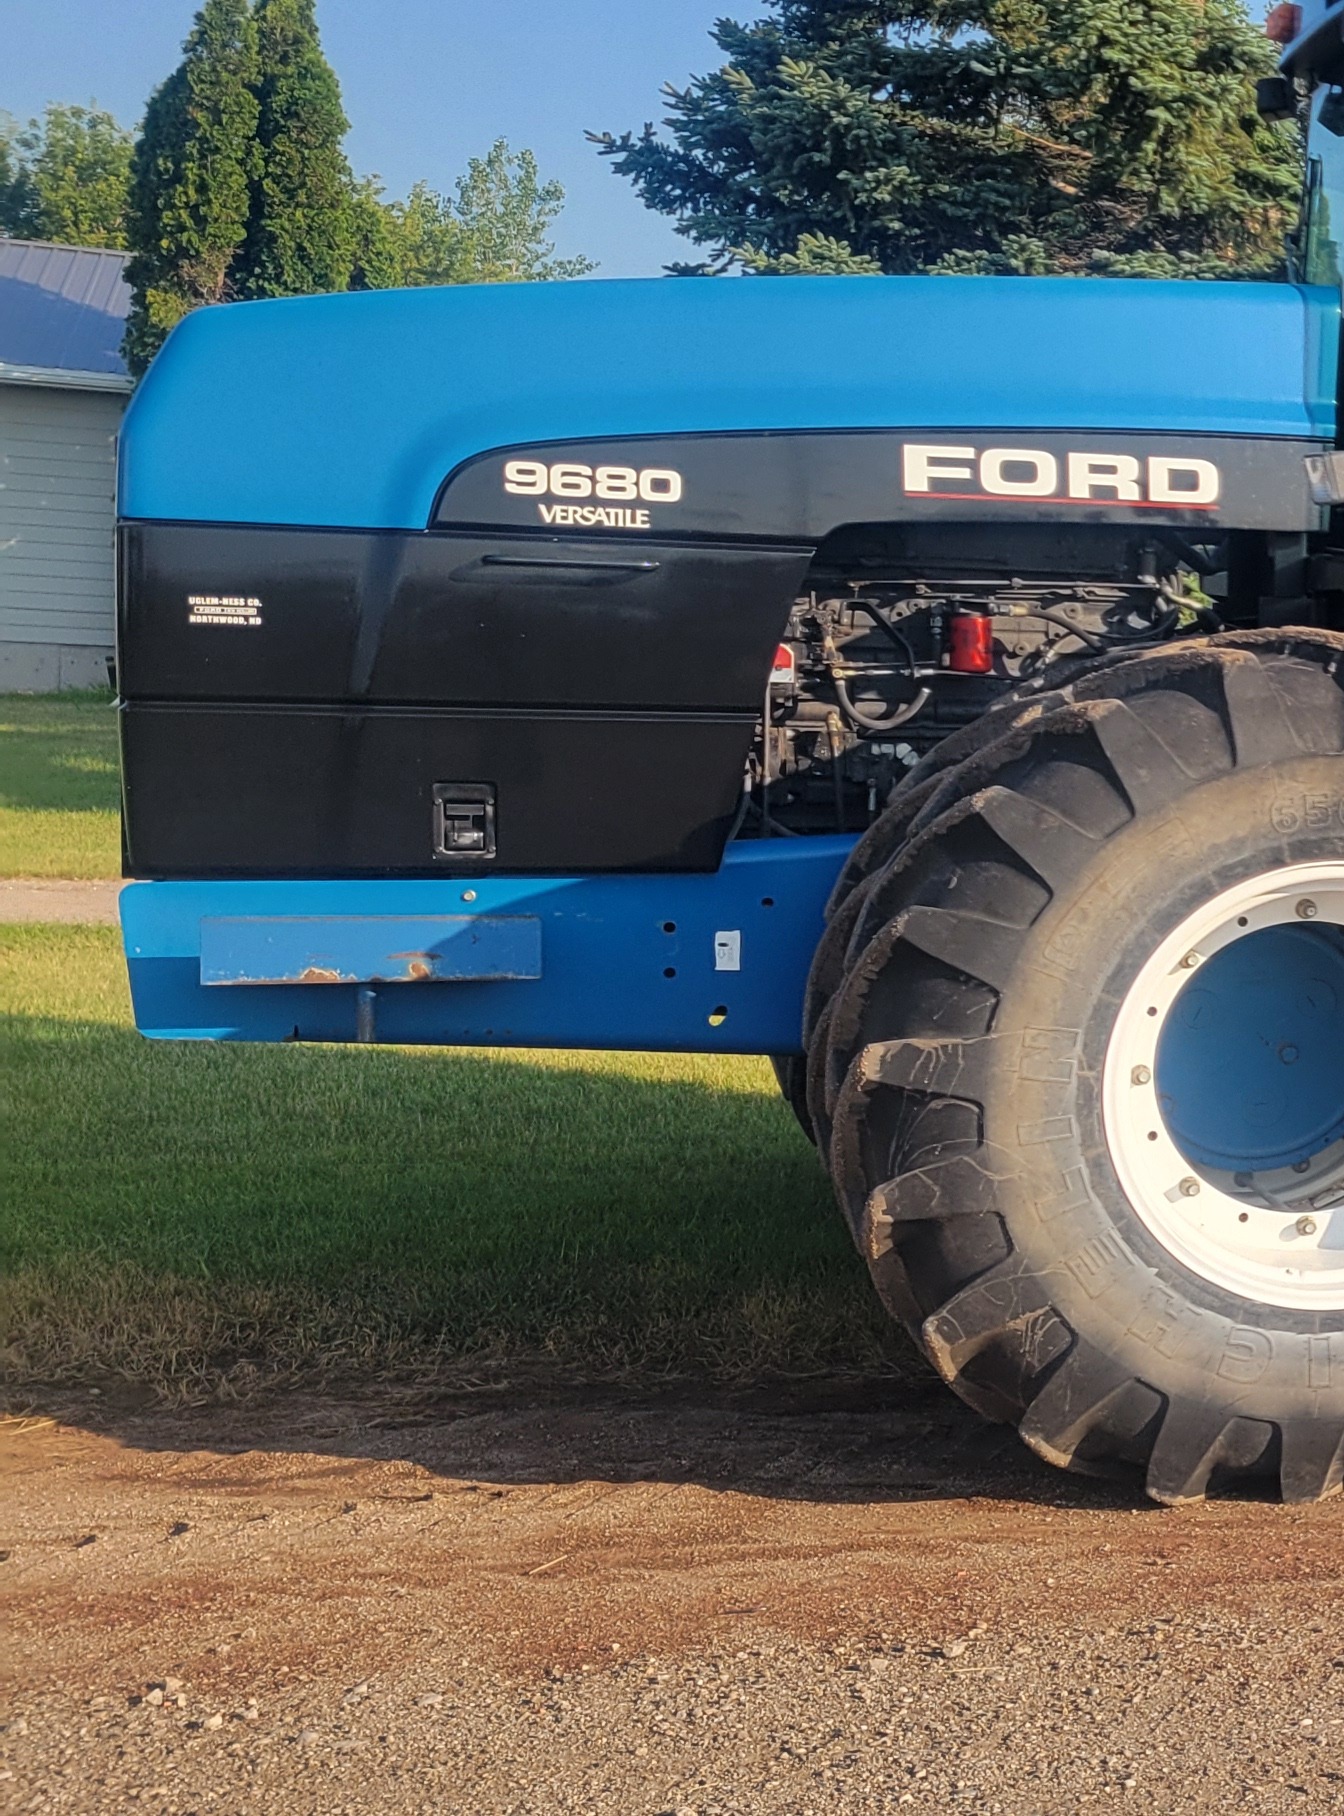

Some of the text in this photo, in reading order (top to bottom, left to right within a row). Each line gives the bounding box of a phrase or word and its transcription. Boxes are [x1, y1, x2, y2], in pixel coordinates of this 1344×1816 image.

[504, 461, 682, 503] 9680
[903, 444, 1219, 504] FORD
[538, 503, 651, 529] VERSATILE
[247, 597, 263, 607] CO.
[189, 615, 262, 625] NORTHWOOD, ND
